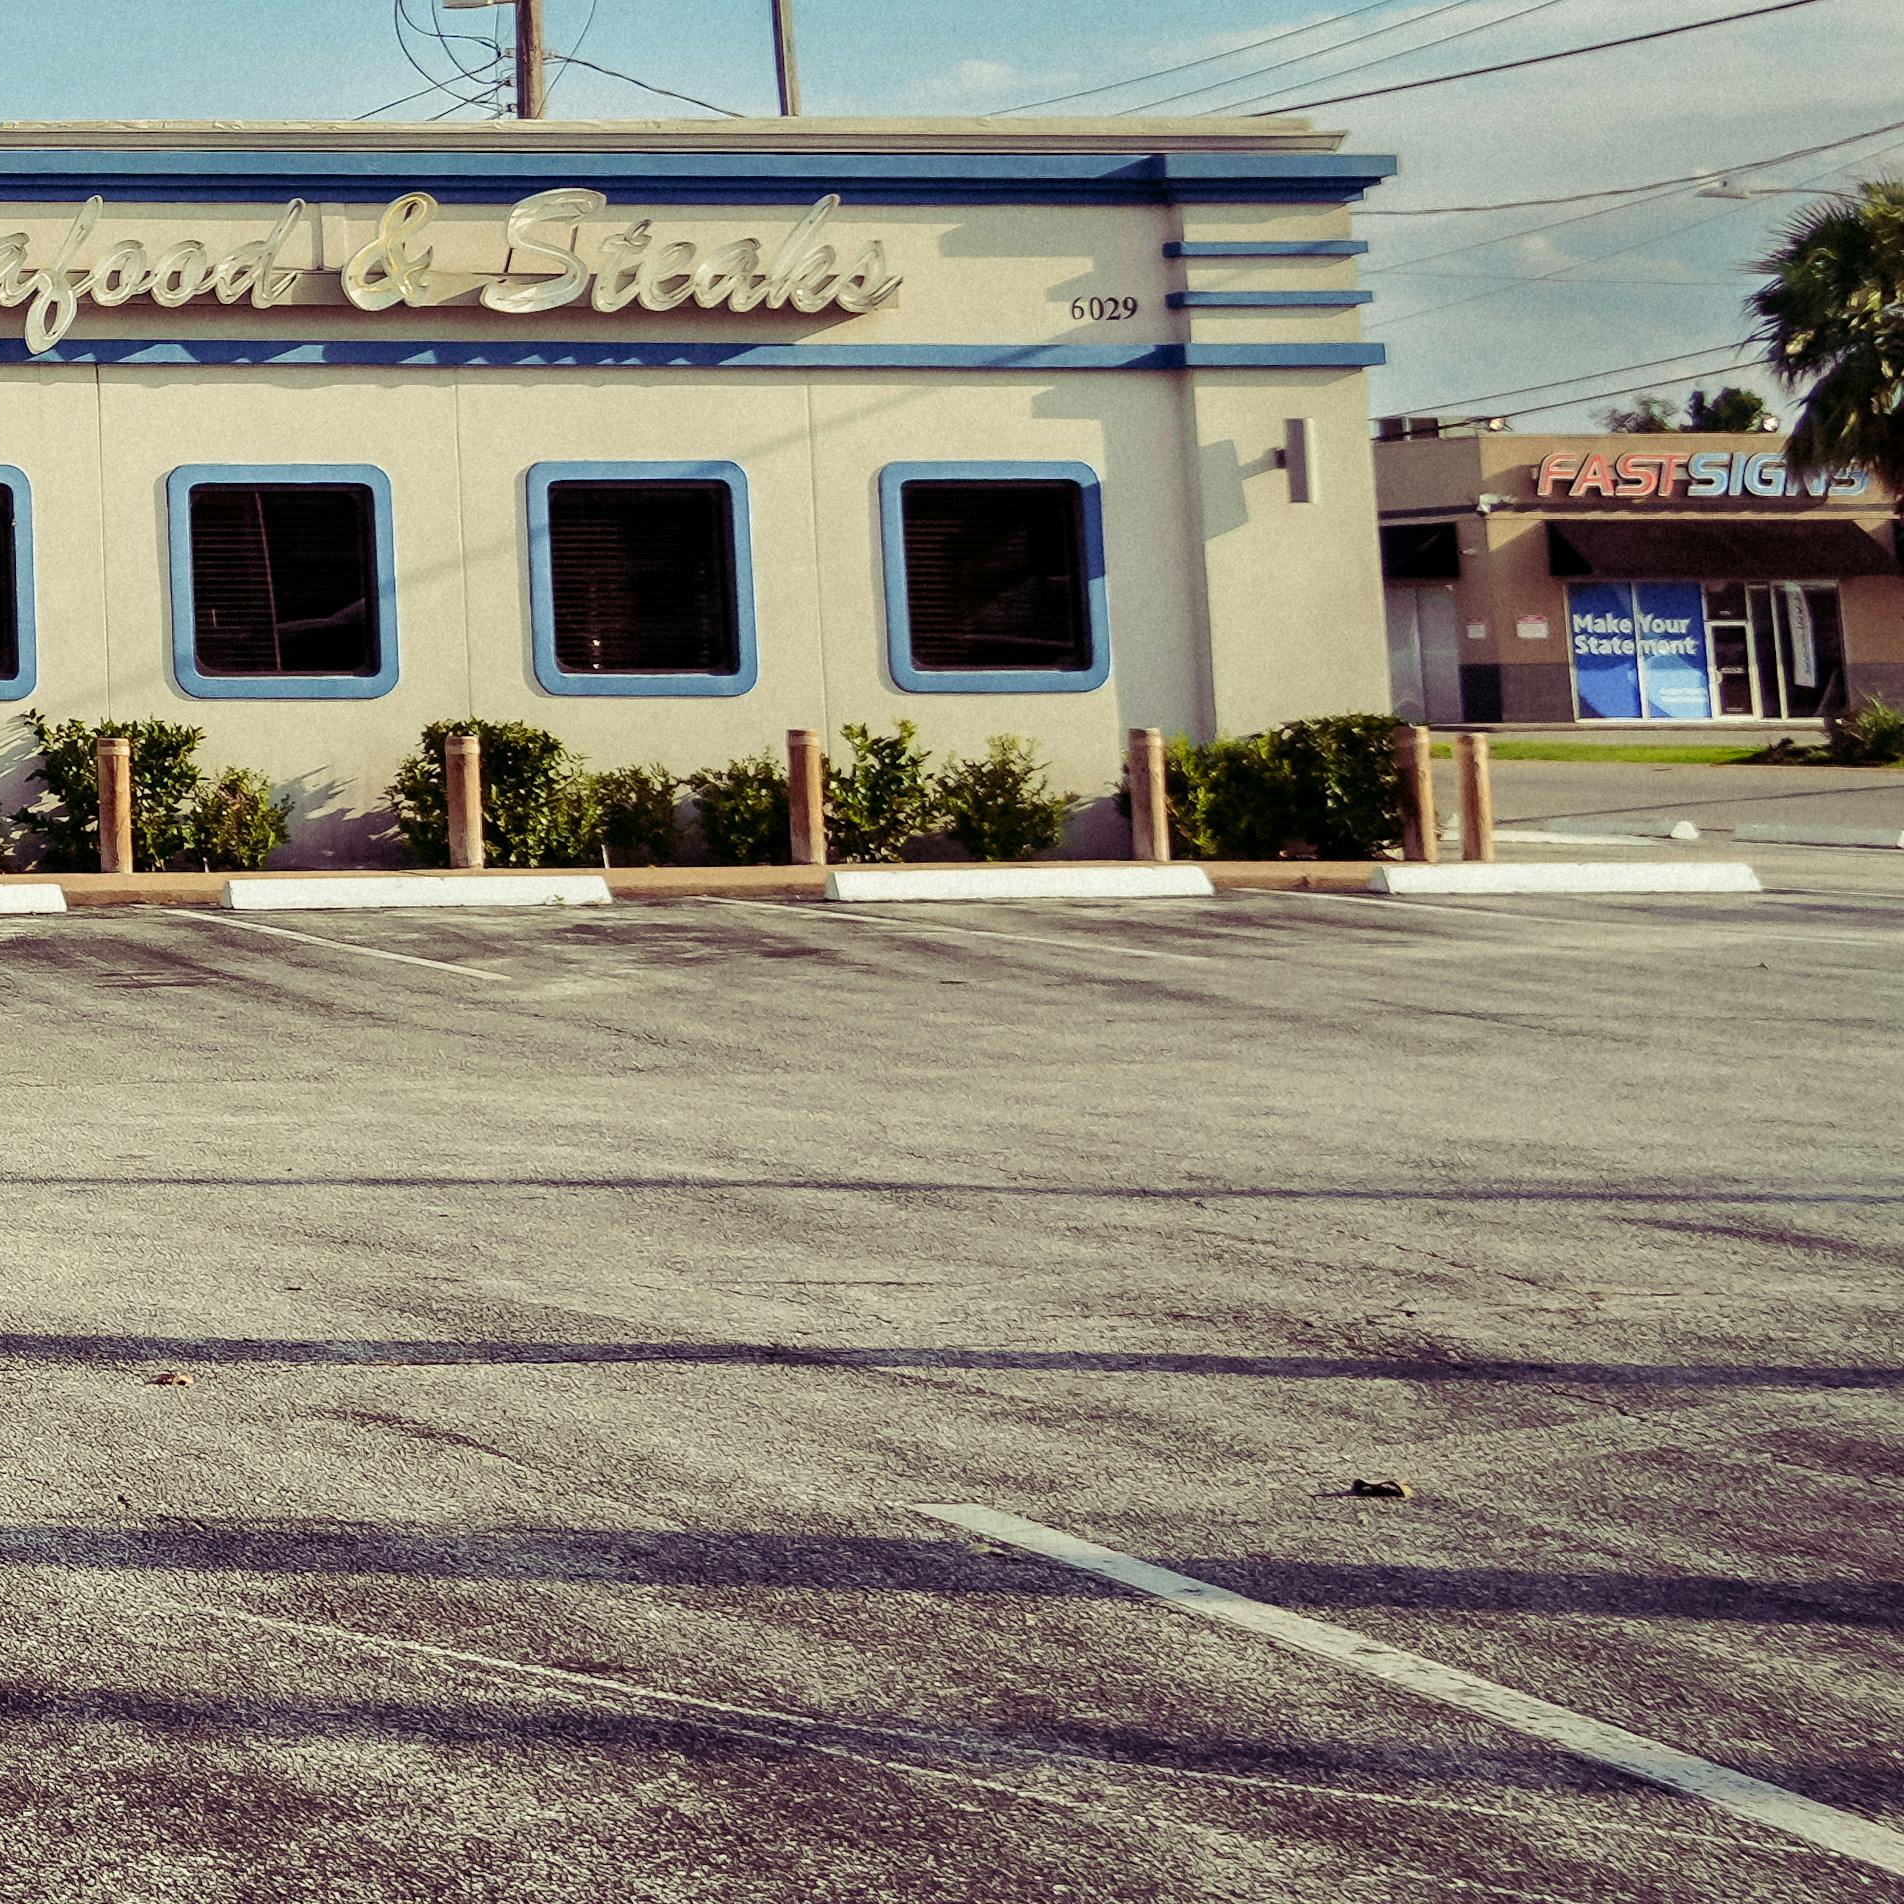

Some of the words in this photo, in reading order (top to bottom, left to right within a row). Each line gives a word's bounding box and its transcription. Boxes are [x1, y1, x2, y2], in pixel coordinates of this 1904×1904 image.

[341, 192, 439, 313] &
[480, 187, 904, 313] Steaks
[1071, 297, 1138, 321] 6029
[1572, 612, 1632, 634] Make
[1637, 612, 1692, 634] Your
[1574, 634, 1699, 656] Statement
